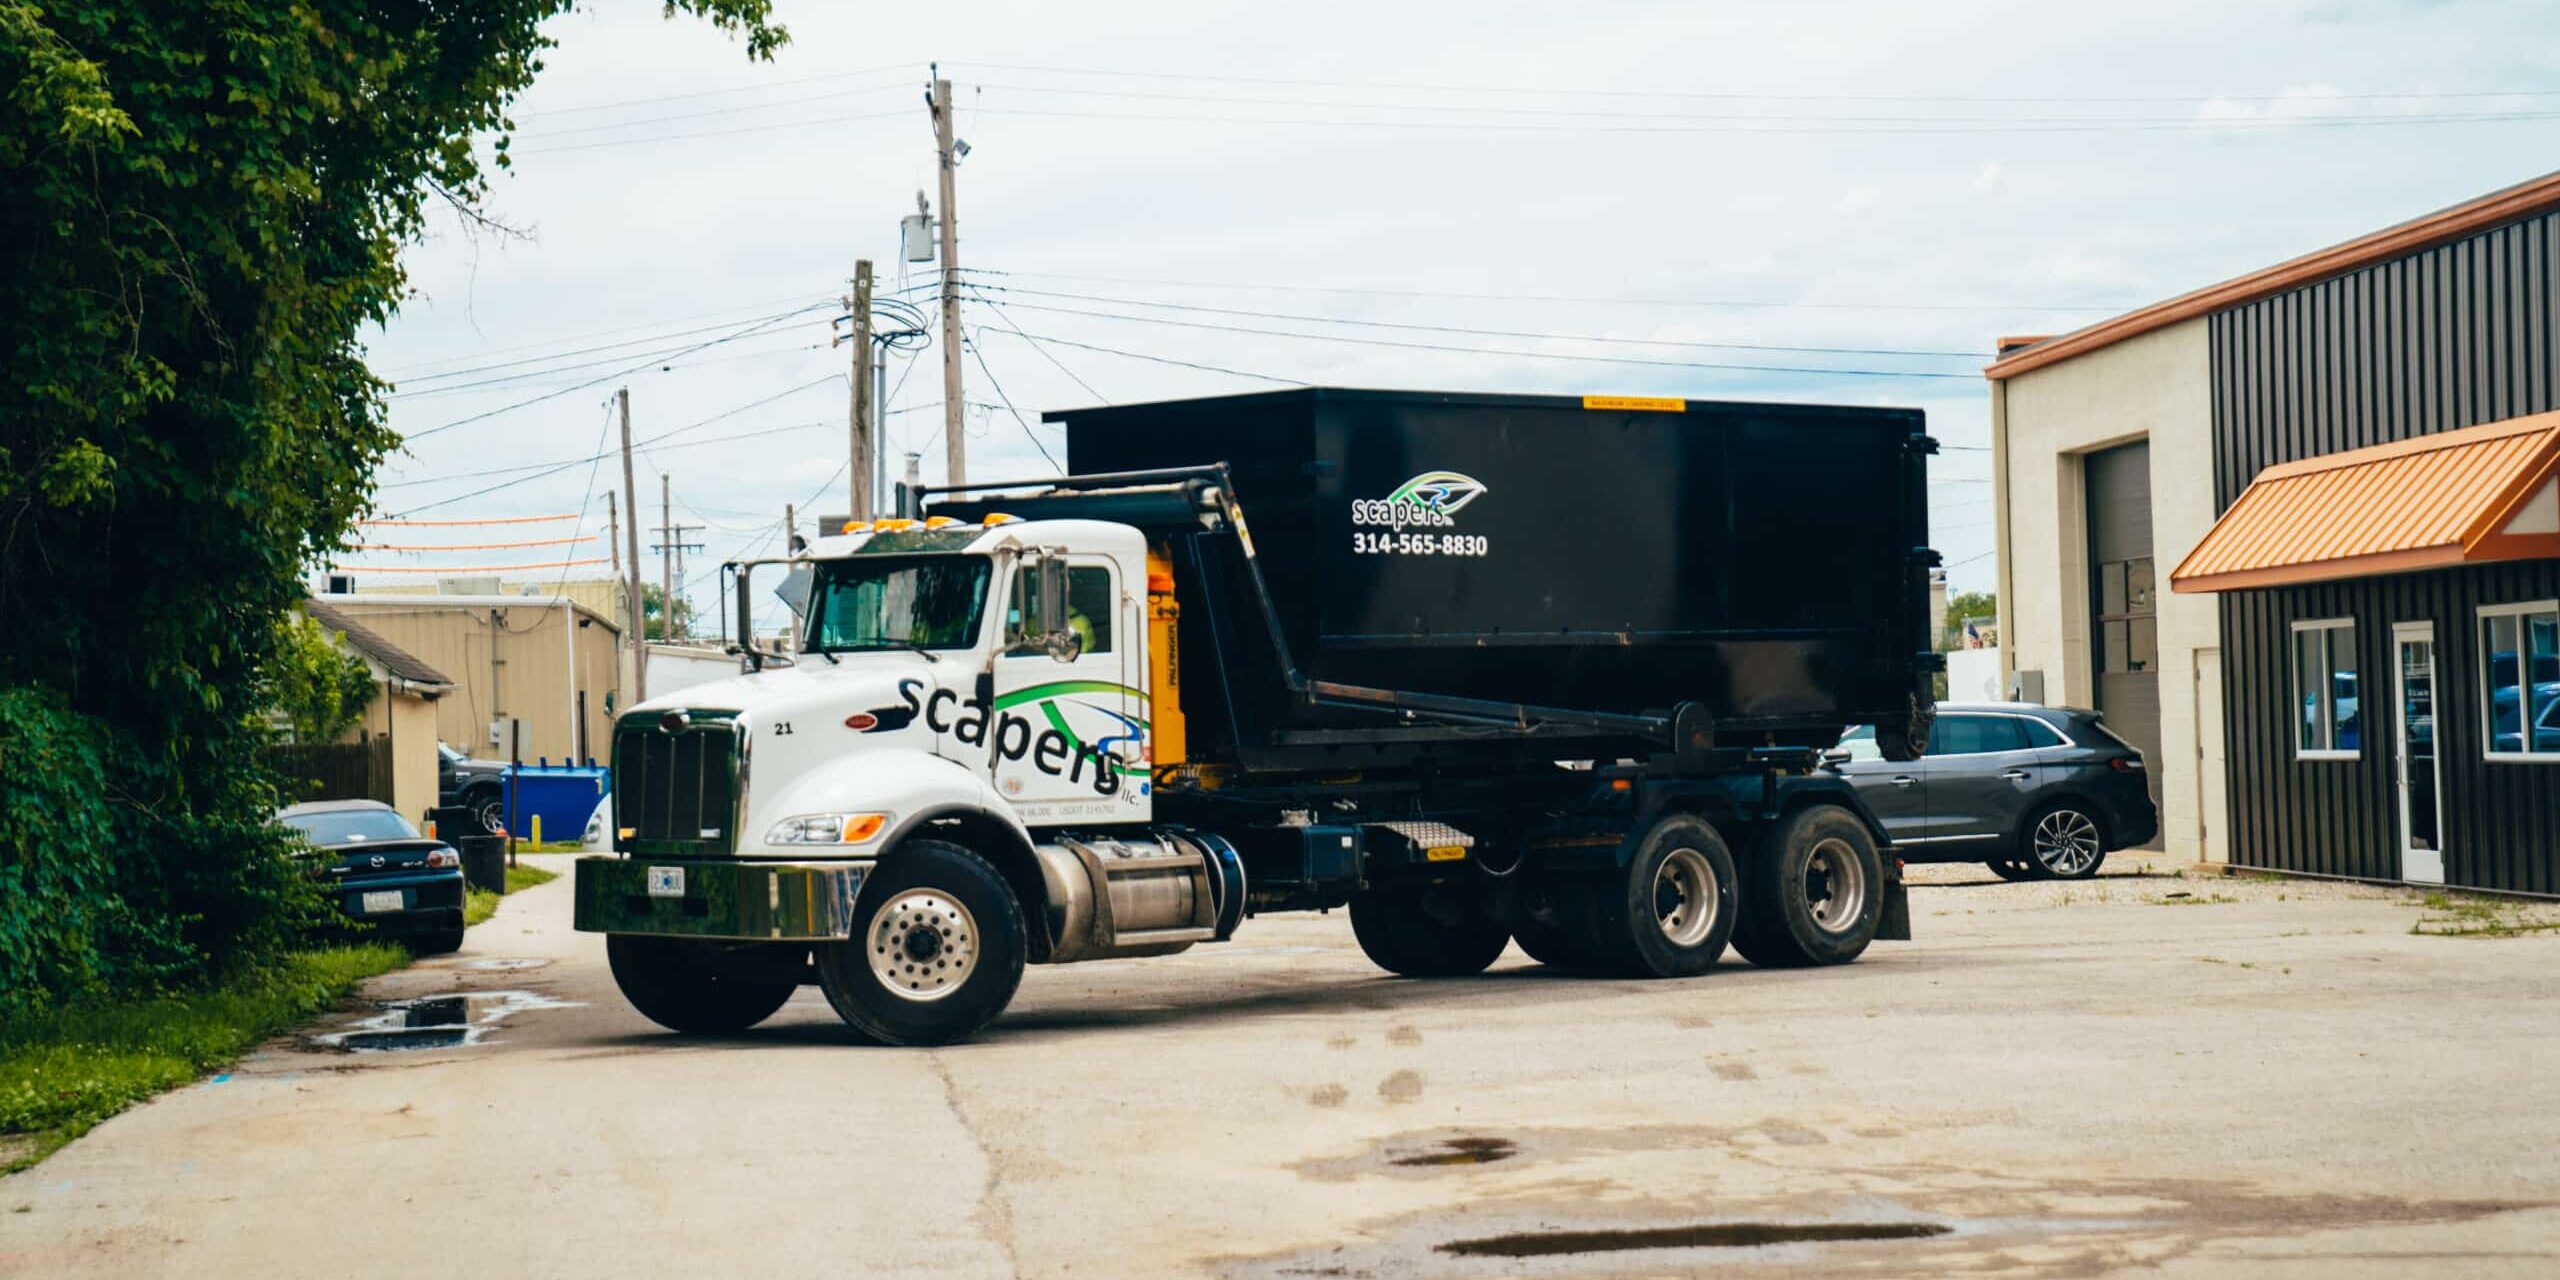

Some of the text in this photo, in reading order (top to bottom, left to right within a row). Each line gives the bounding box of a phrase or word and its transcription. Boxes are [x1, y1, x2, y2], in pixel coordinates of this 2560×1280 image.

[1352, 499, 1445, 531] scapers
[1353, 532, 1488, 556] 314-565-8830
[774, 721, 793, 735] 21
[898, 678, 1123, 795] scapers
